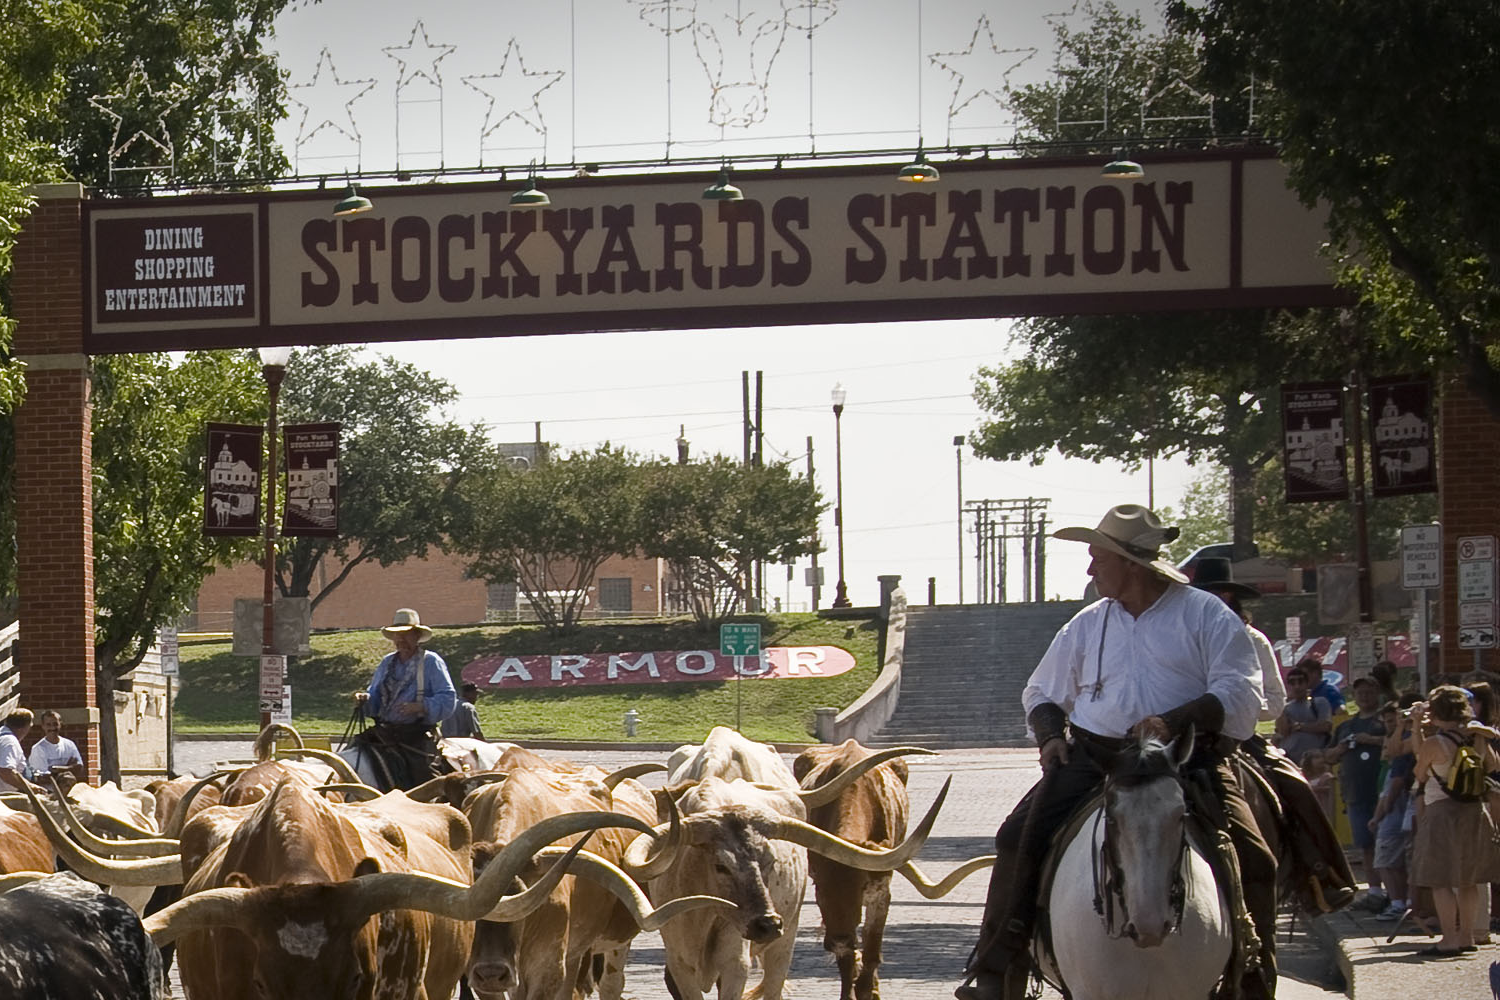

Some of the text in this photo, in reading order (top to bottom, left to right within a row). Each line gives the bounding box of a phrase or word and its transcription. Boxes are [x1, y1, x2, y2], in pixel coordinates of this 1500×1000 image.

[145, 227, 203, 250] DINING
[301, 180, 1192, 307] STOCKYARDS STATION
[135, 256, 215, 280] SHOPPING
[105, 284, 245, 311] ENTERTAINMENT
[488, 646, 827, 685] ARMOUR
